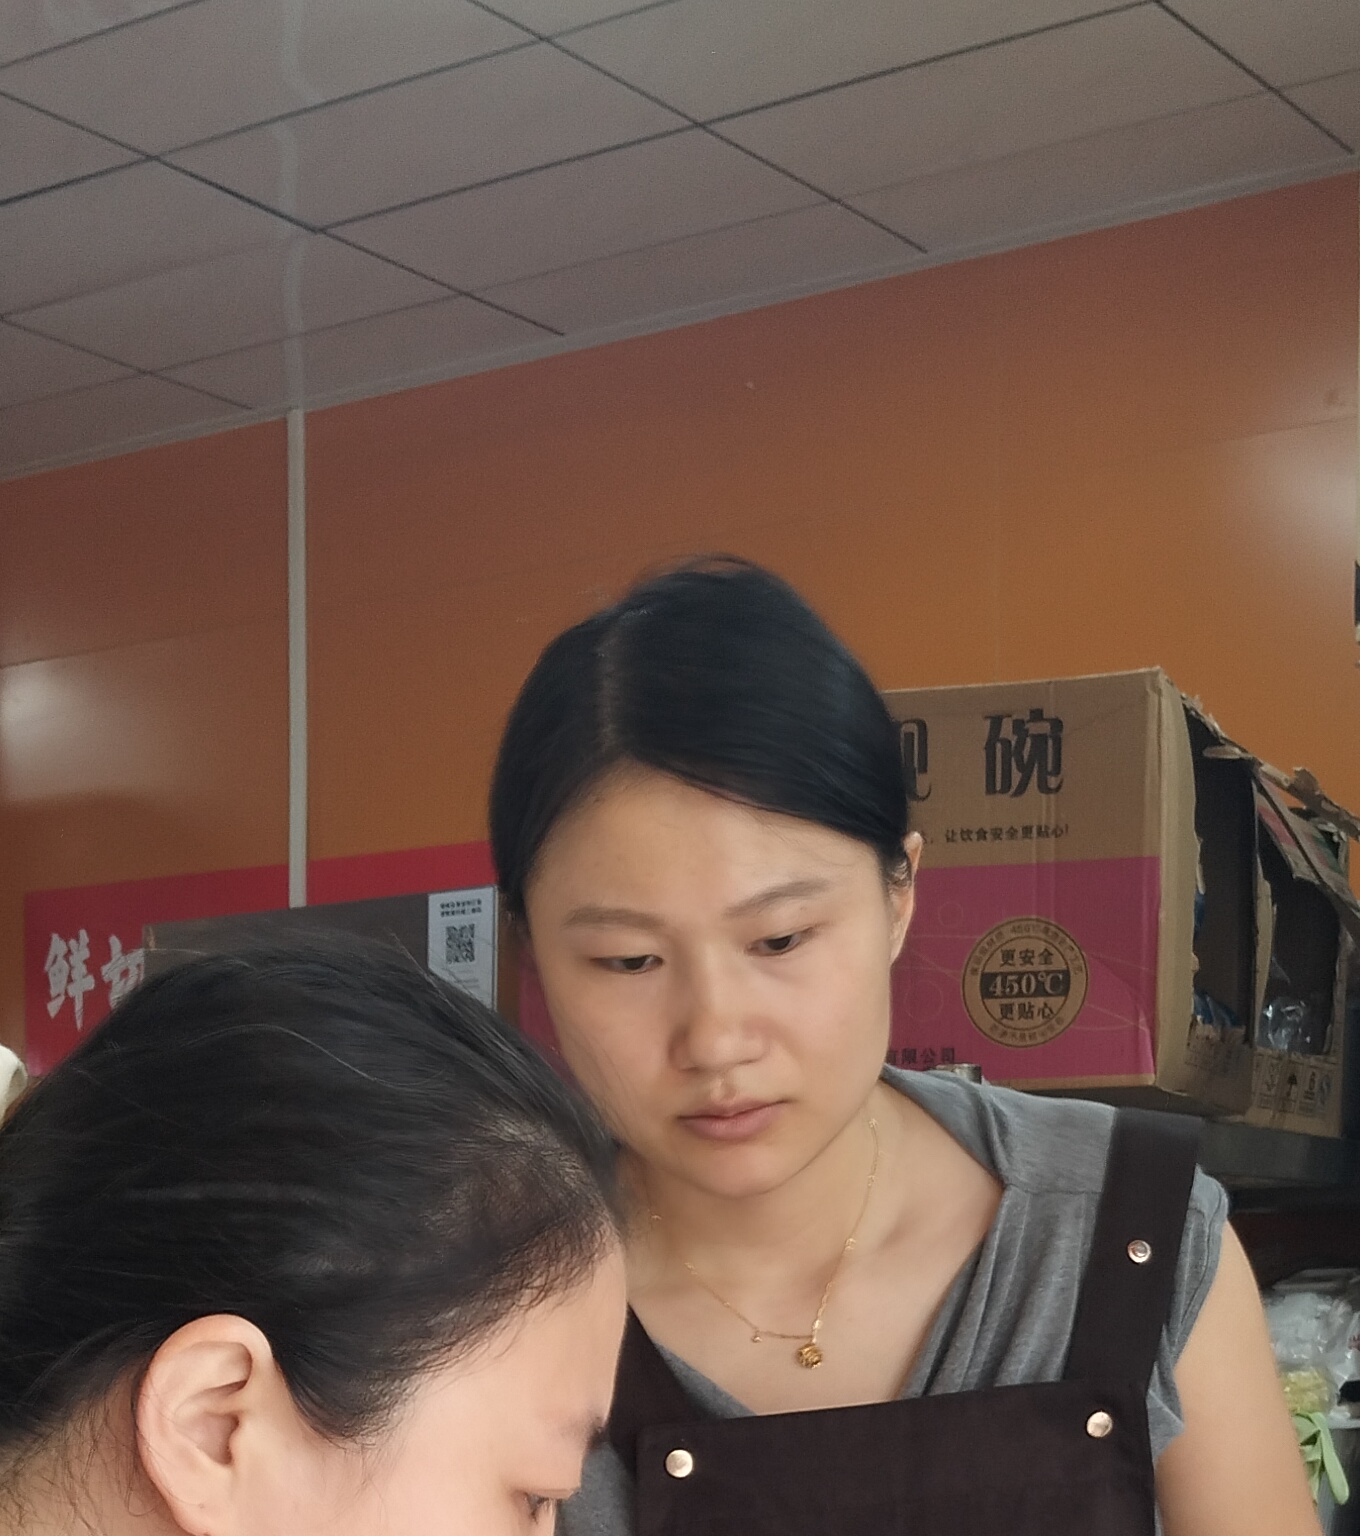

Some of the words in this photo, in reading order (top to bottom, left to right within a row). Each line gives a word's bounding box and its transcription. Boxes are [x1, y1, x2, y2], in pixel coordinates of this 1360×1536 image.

[1000, 948, 1054, 967] 更安全
[1000, 1002, 1055, 1021] 更贴心
